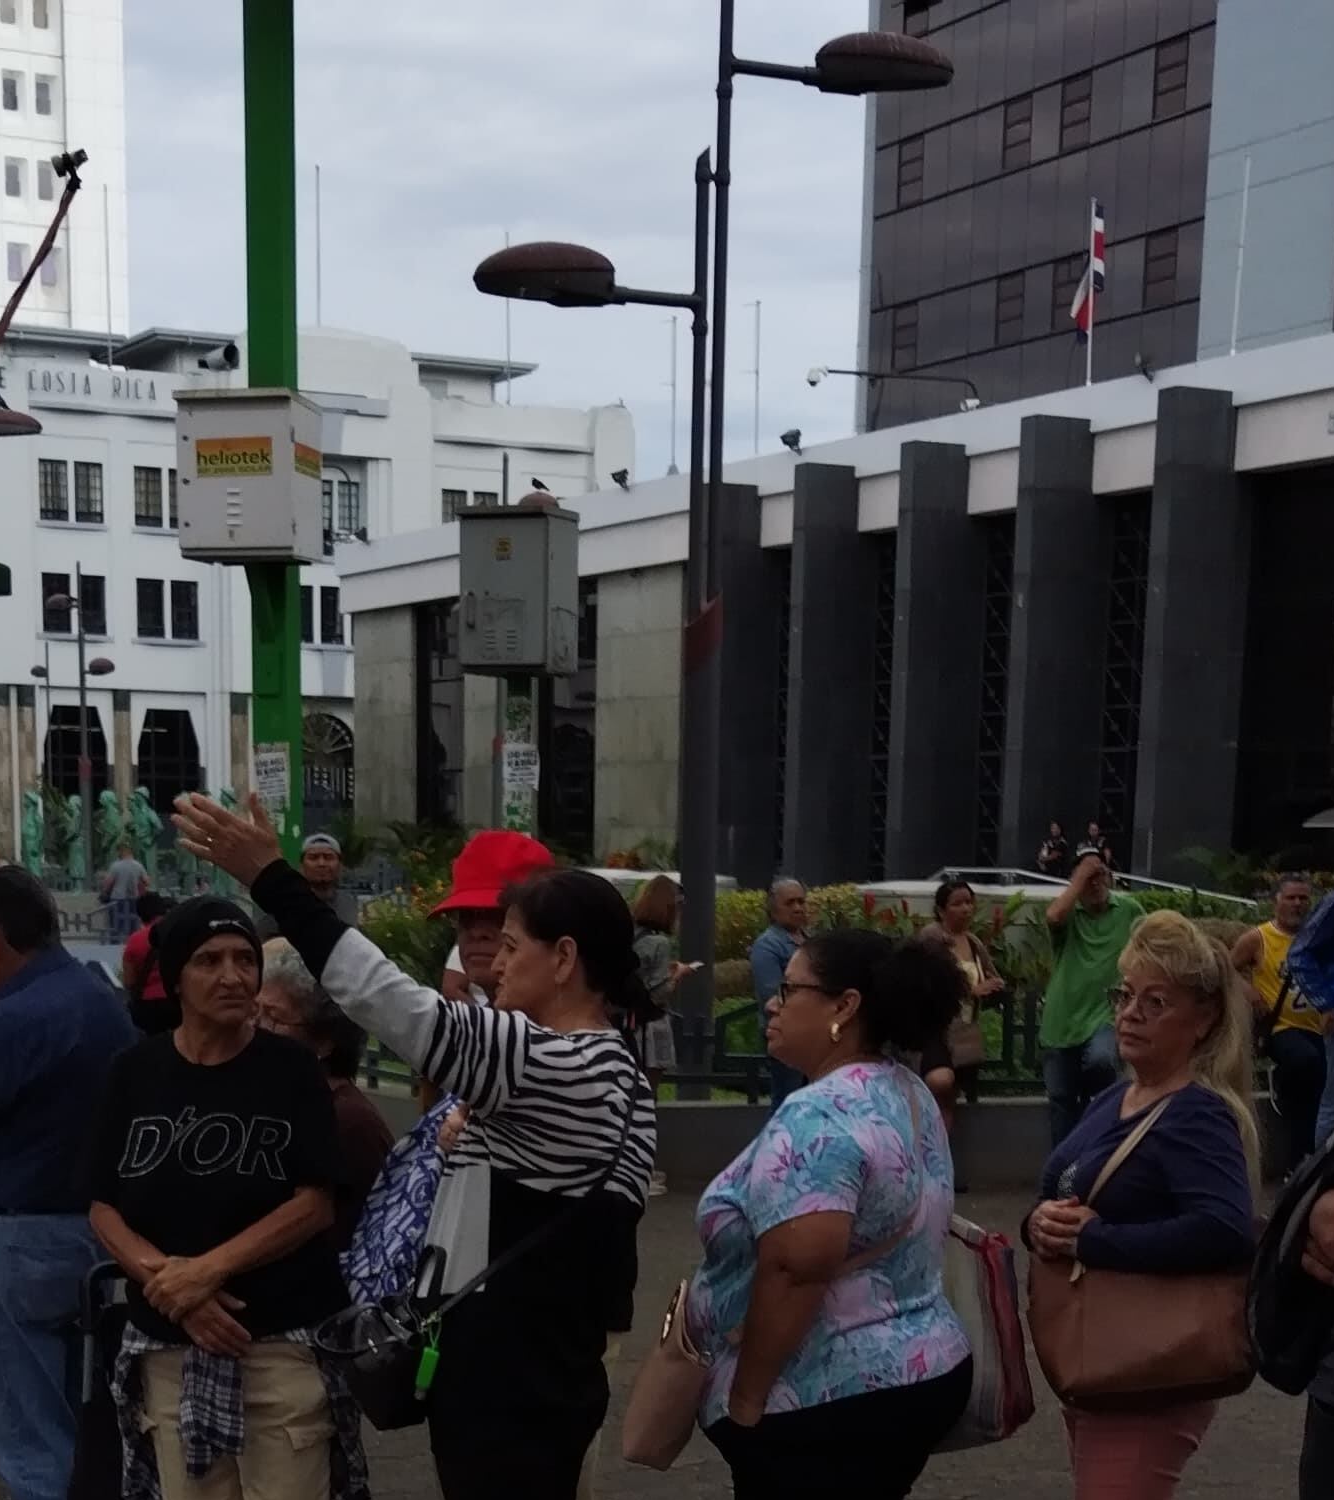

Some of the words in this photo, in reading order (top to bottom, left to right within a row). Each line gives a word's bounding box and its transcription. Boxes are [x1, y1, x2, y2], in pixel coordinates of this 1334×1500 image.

[28, 369, 91, 396] COSTA
[112, 375, 156, 401] RICA
[196, 448, 271, 466] heliotek
